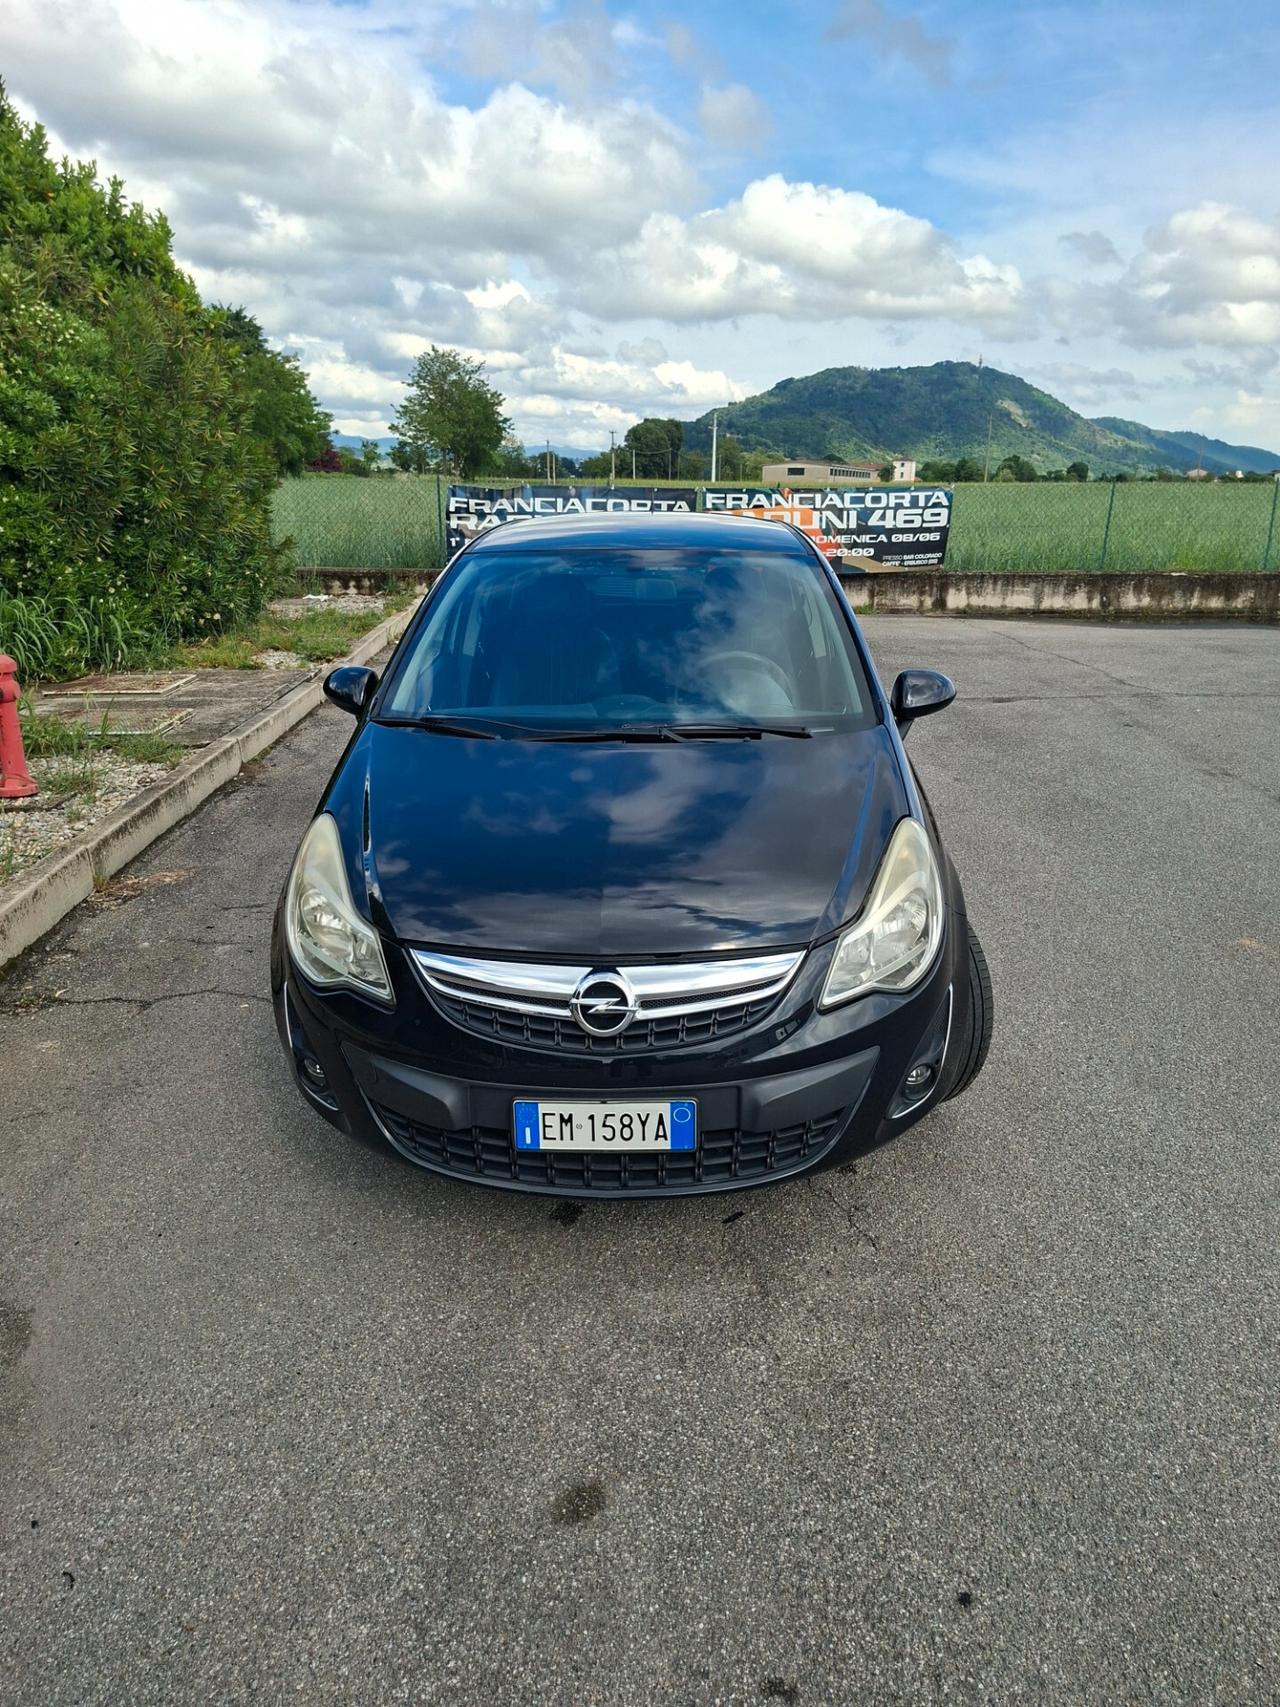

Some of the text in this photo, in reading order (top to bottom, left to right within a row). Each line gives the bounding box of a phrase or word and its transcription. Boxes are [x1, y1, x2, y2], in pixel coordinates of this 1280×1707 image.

[449, 496, 690, 513] FRANCIACORTA
[705, 490, 949, 509] FRANCIACORTA
[868, 508, 949, 529] 469
[812, 532, 940, 544] OMENICA 08/06
[542, 1113, 669, 1142] EM 158YA
